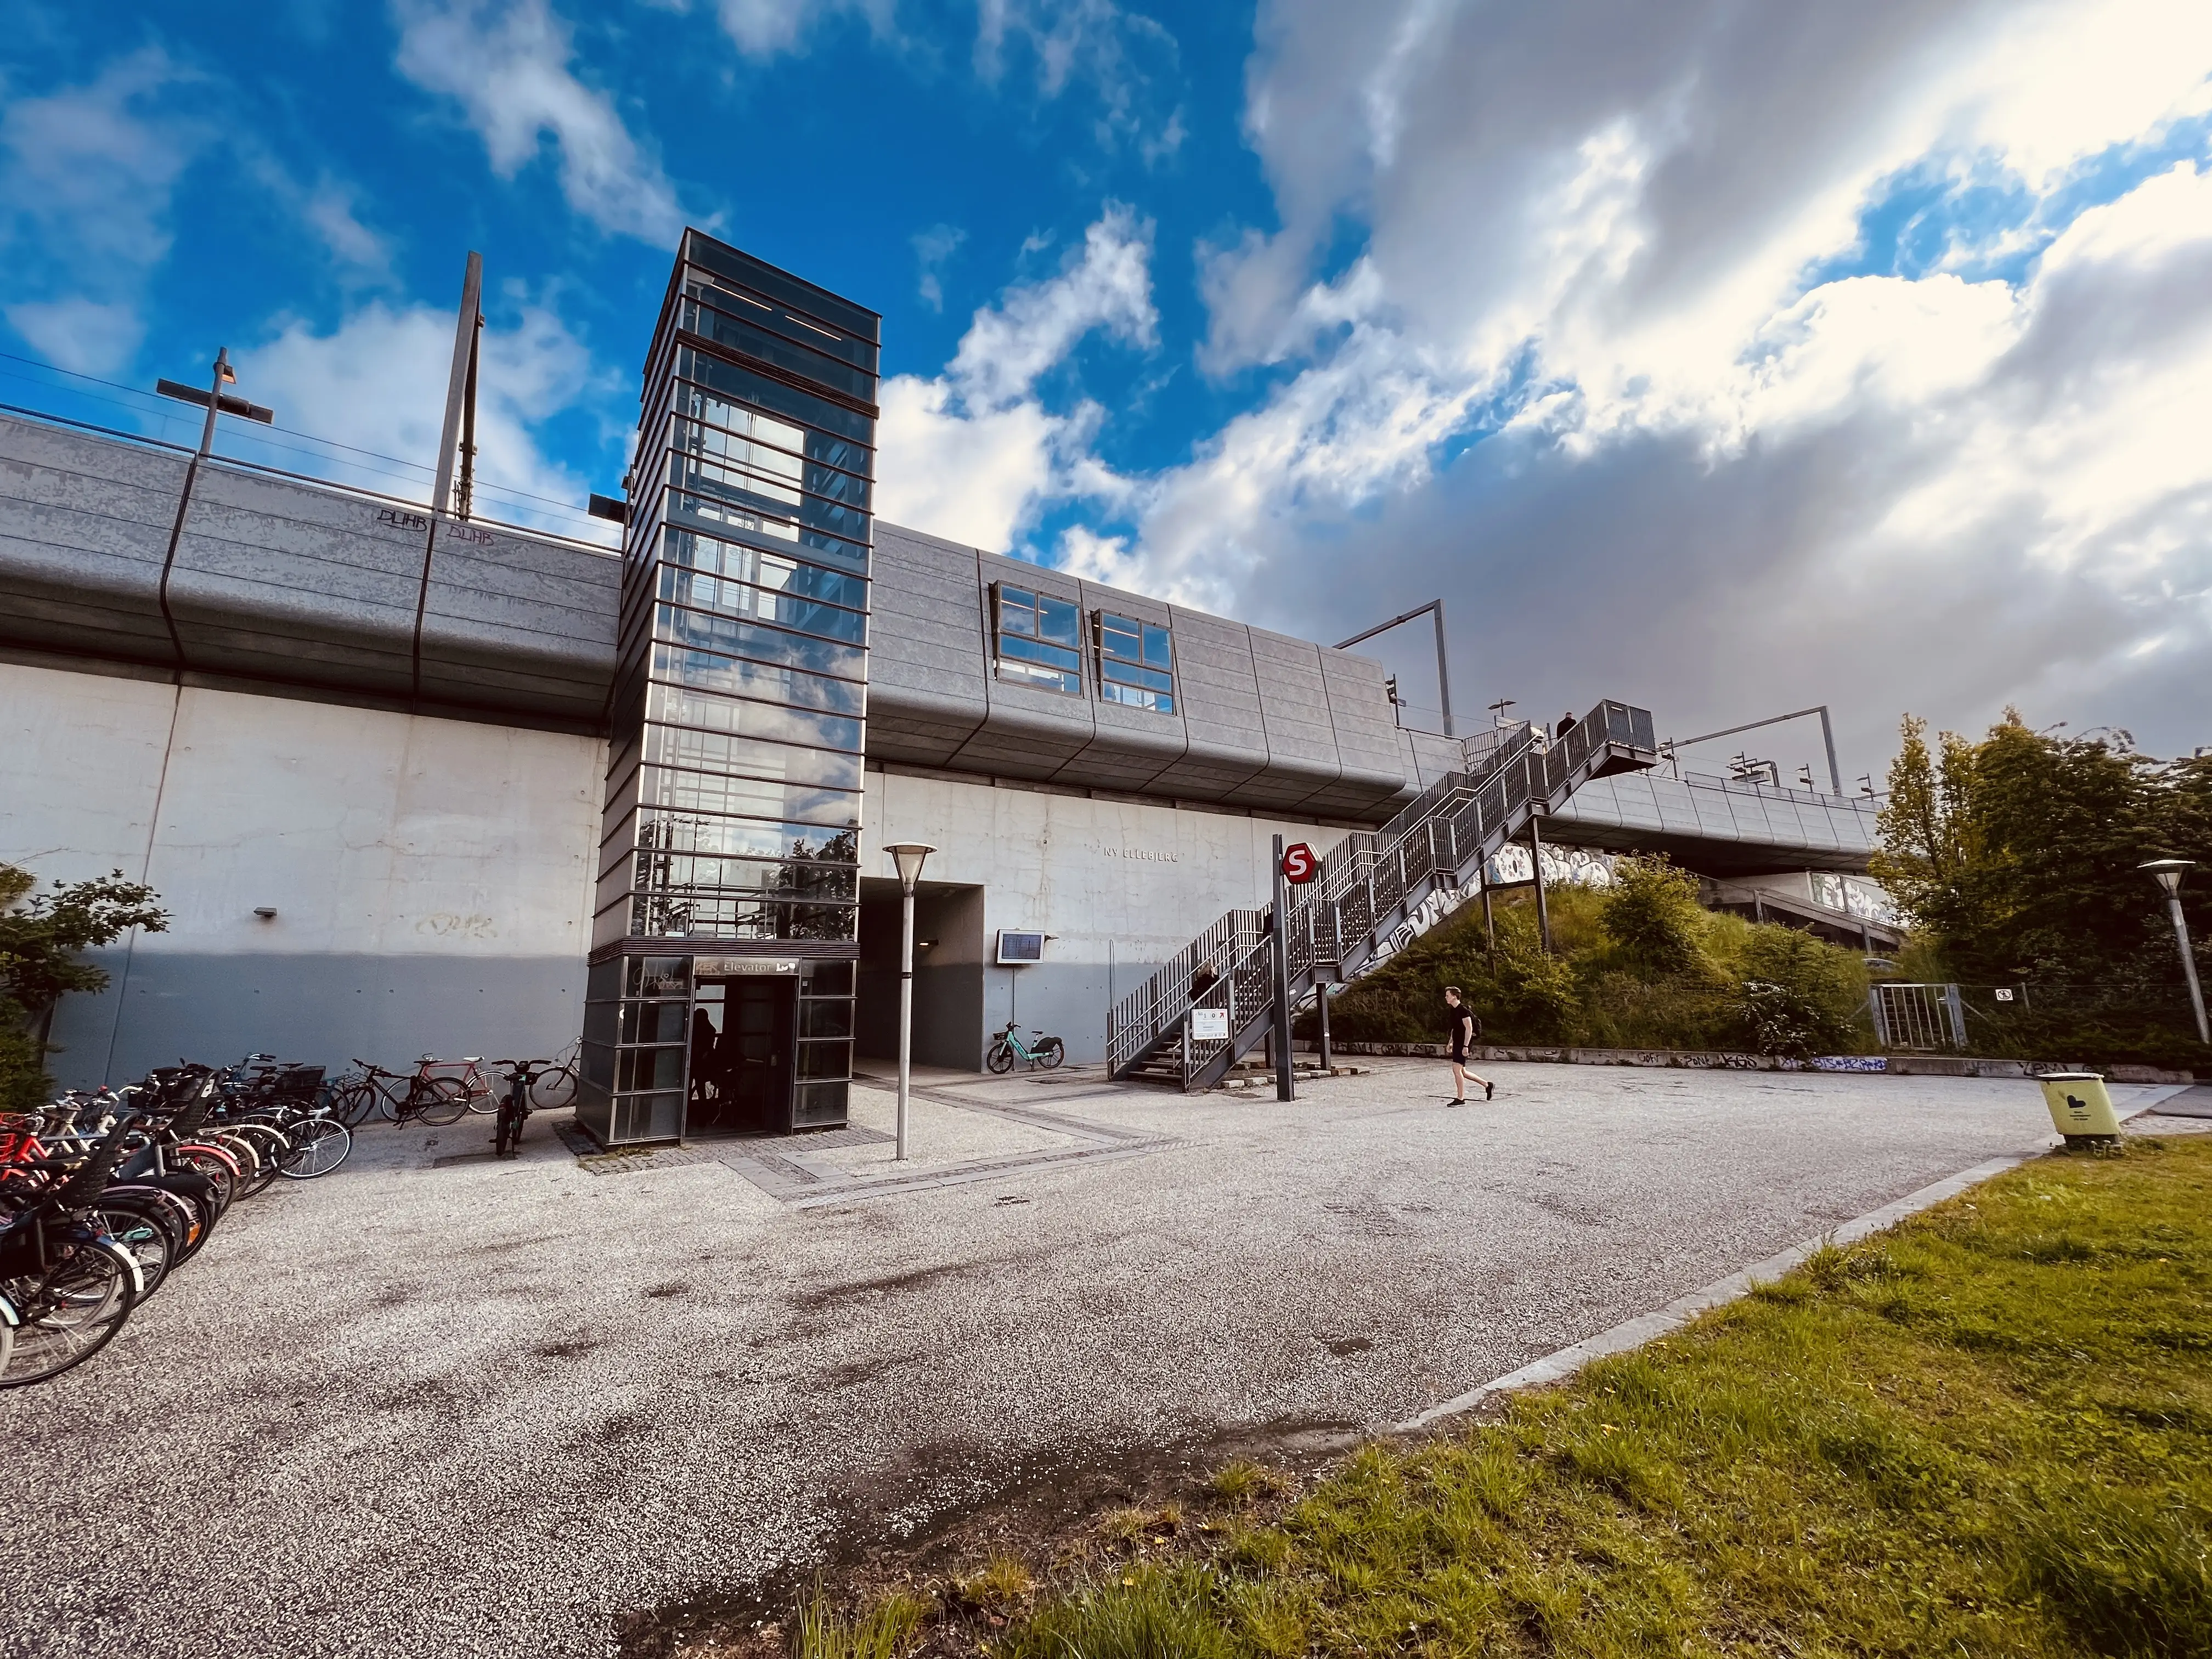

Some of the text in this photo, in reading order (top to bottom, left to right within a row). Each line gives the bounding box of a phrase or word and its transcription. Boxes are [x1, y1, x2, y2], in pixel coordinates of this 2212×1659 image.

[1104, 847, 1178, 862] NY ELLEBJERG
[1289, 850, 1307, 876] S
[724, 961, 771, 972] Elevator
